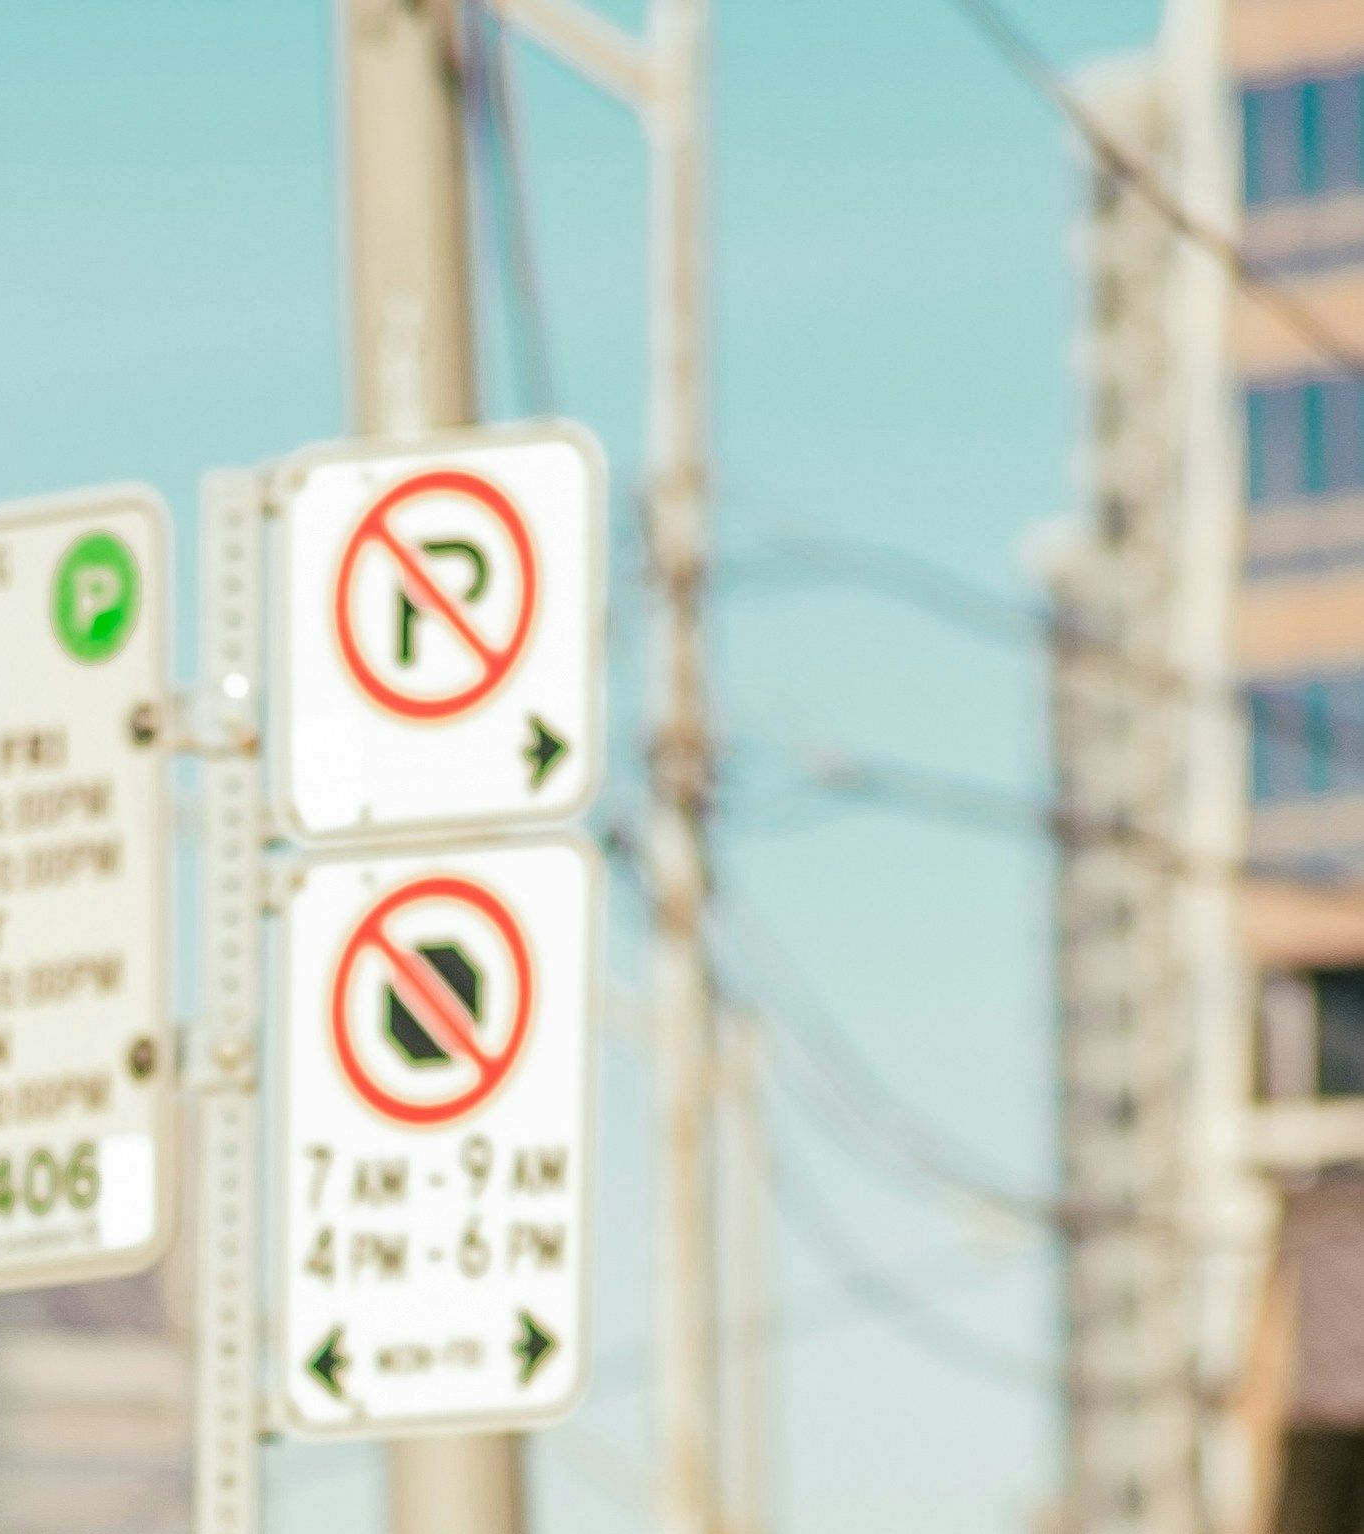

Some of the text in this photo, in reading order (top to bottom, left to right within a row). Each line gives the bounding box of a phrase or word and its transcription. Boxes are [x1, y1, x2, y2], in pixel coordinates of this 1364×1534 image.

[304, 1143, 333, 1211] 7
[459, 1132, 493, 1198] 9
[303, 1223, 334, 1286] 4
[457, 1214, 492, 1280] 6
